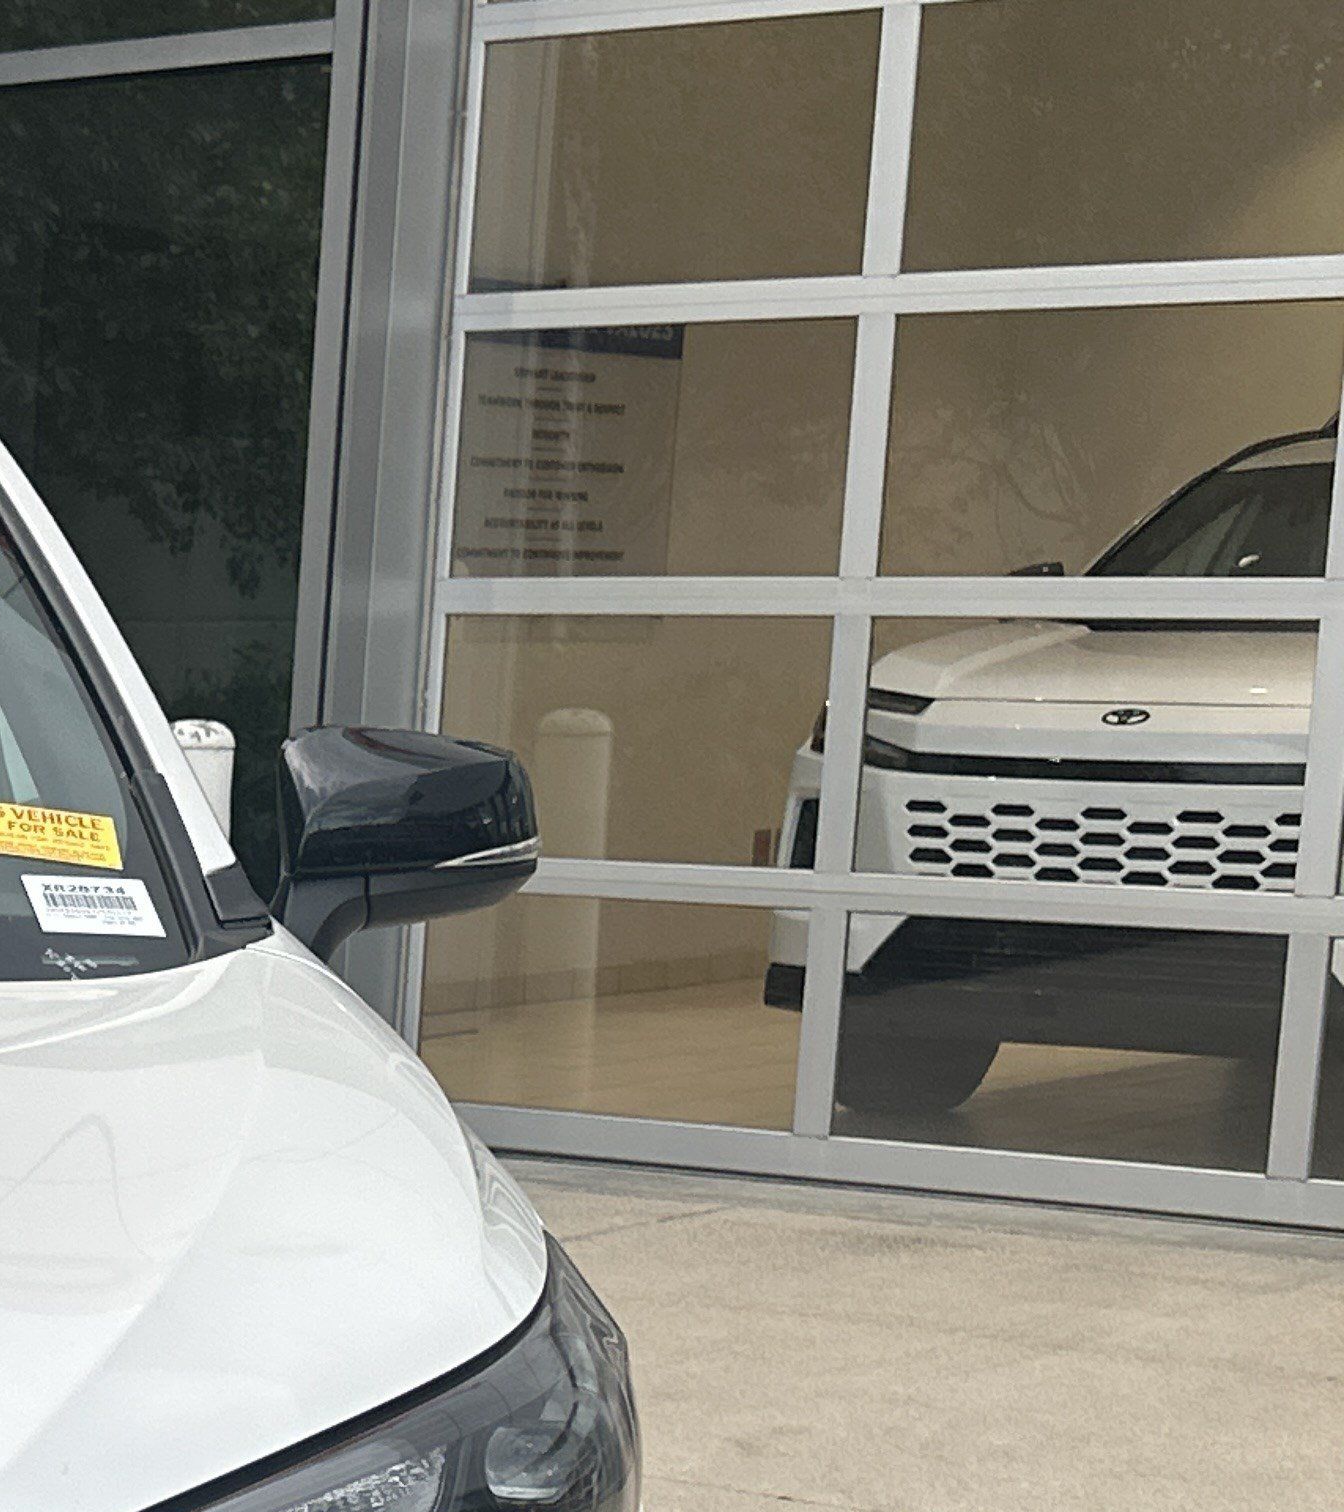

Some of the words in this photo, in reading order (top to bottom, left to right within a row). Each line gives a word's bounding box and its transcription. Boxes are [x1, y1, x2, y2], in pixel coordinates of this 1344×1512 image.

[10, 807, 105, 831] VEHICLE
[8, 820, 45, 836] FOR
[52, 826, 100, 842] SALE
